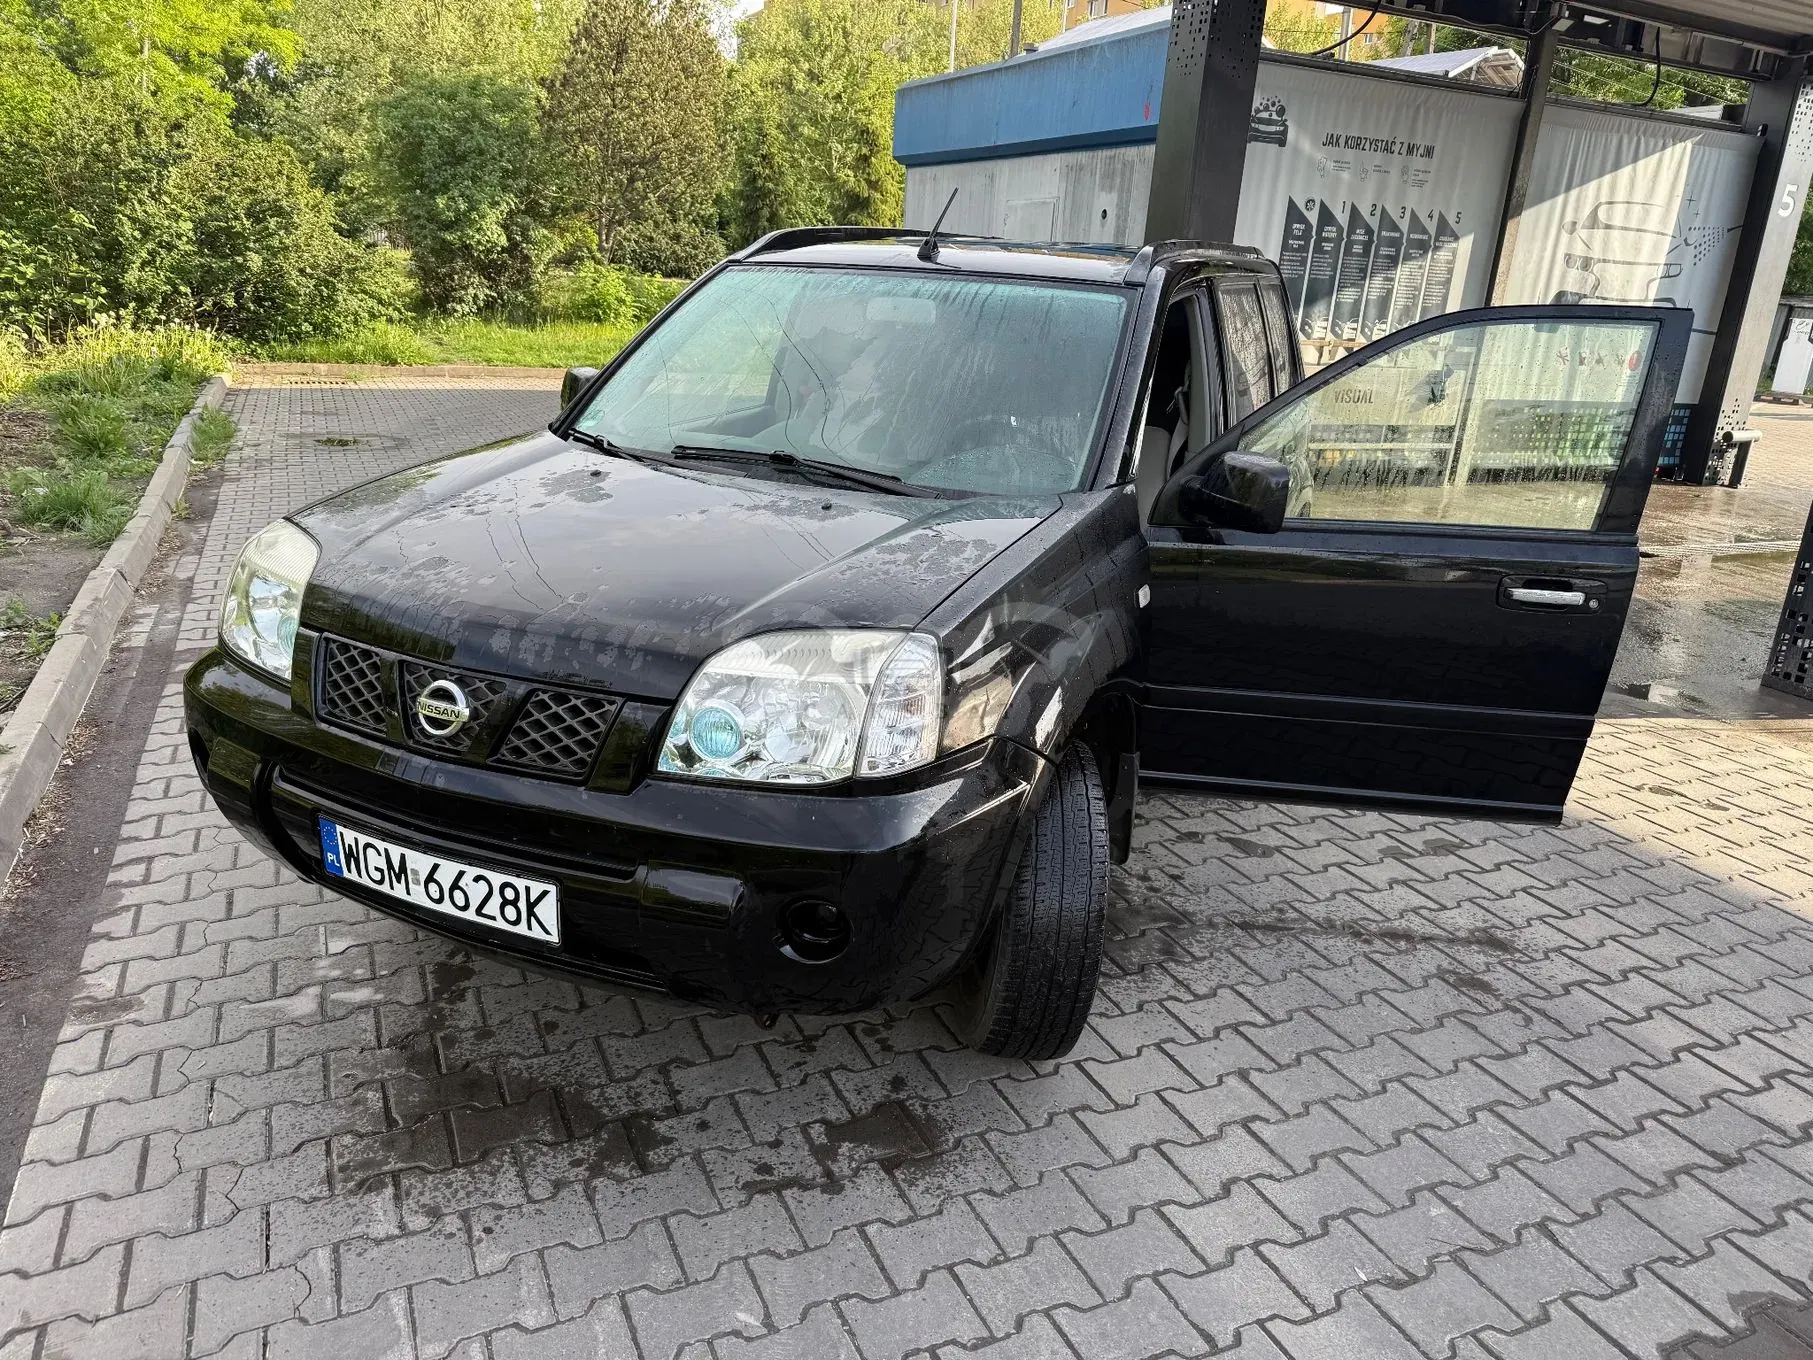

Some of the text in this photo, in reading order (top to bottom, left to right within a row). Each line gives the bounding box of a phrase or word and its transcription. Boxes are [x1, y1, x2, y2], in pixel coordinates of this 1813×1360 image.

[1322, 132, 1435, 159] JAK KORZYSTAĆ Z MYJNI
[1341, 200, 1347, 214] 1
[1777, 183, 1799, 217] 5
[1370, 203, 1378, 217] 2
[1400, 206, 1407, 220] 3
[1427, 208, 1435, 222] 4
[1455, 211, 1463, 225] 5
[417, 701, 460, 719] NISSAN
[327, 852, 340, 867] PL
[339, 831, 553, 936] WGM 6628K
